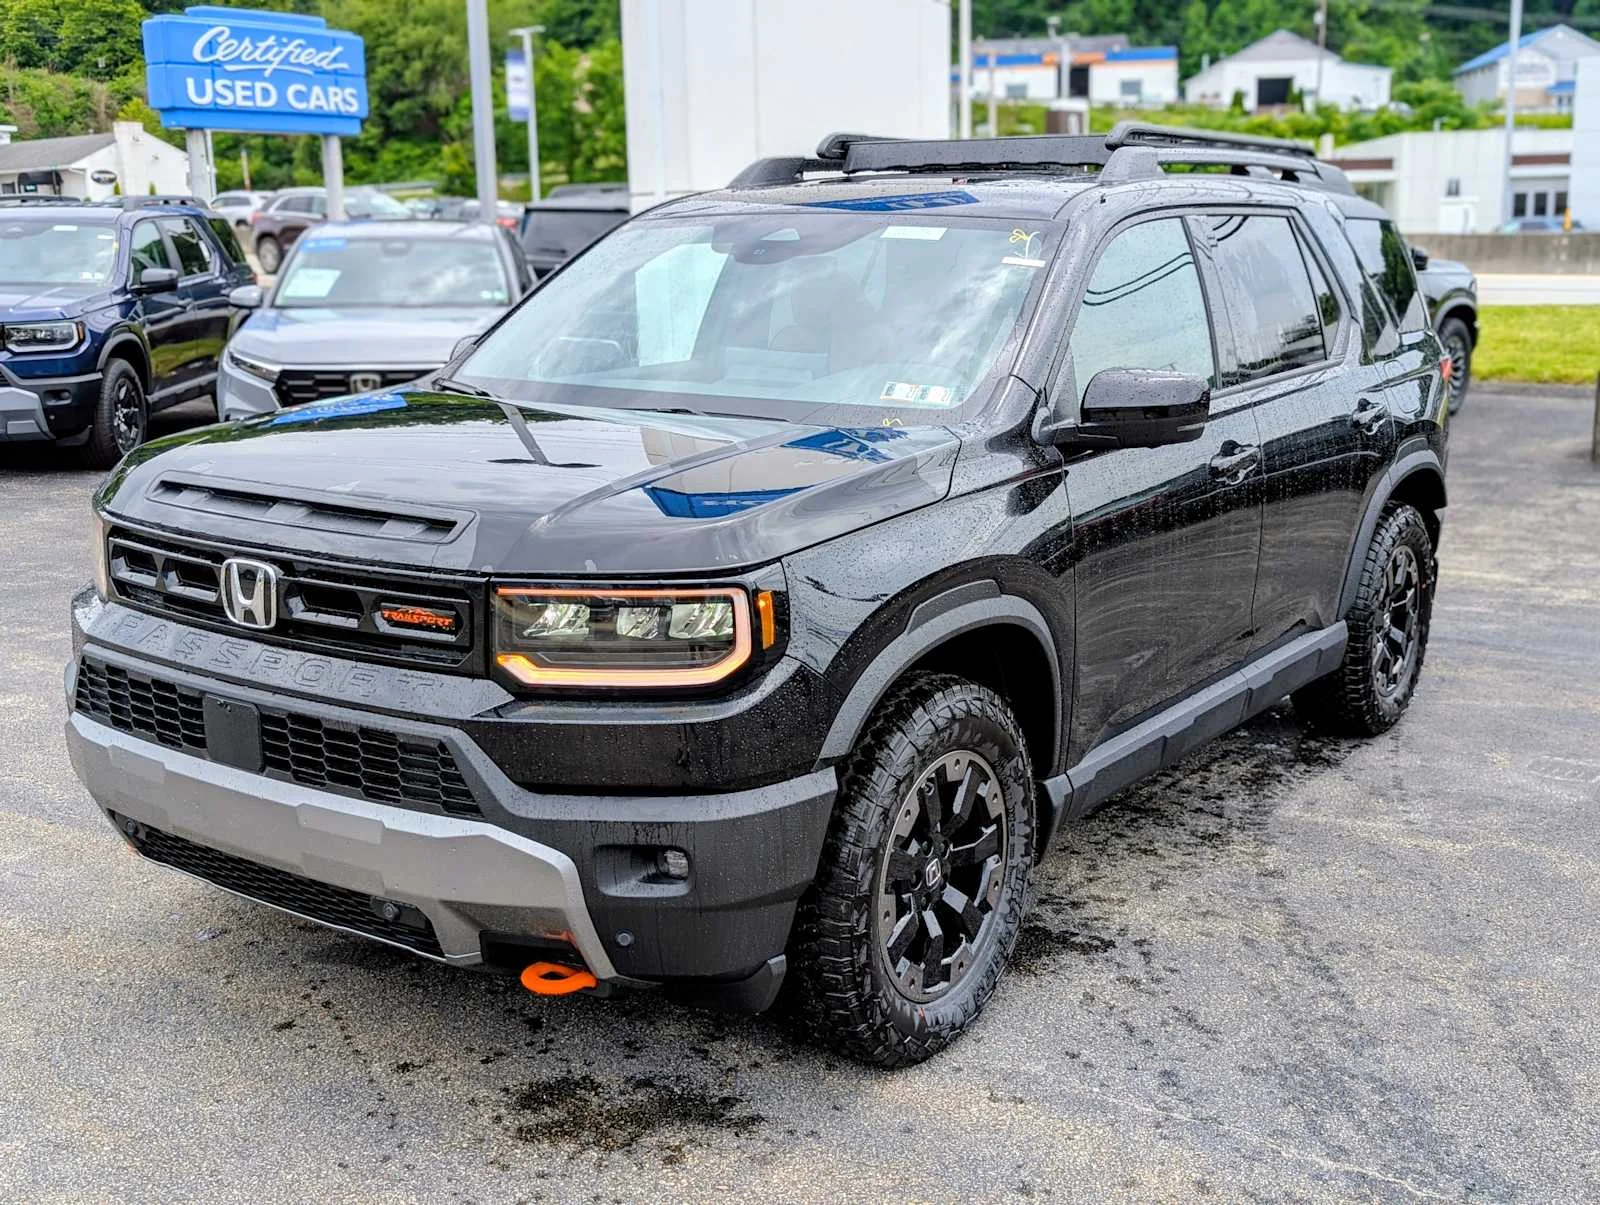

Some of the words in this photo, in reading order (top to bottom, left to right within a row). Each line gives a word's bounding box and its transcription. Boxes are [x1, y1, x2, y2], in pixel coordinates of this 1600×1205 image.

[193, 27, 348, 77] Certified
[186, 78, 277, 107] USED
[287, 85, 359, 112] CARS
[381, 609, 453, 627] TRAILSPORT
[112, 612, 446, 700] PASSPORT
